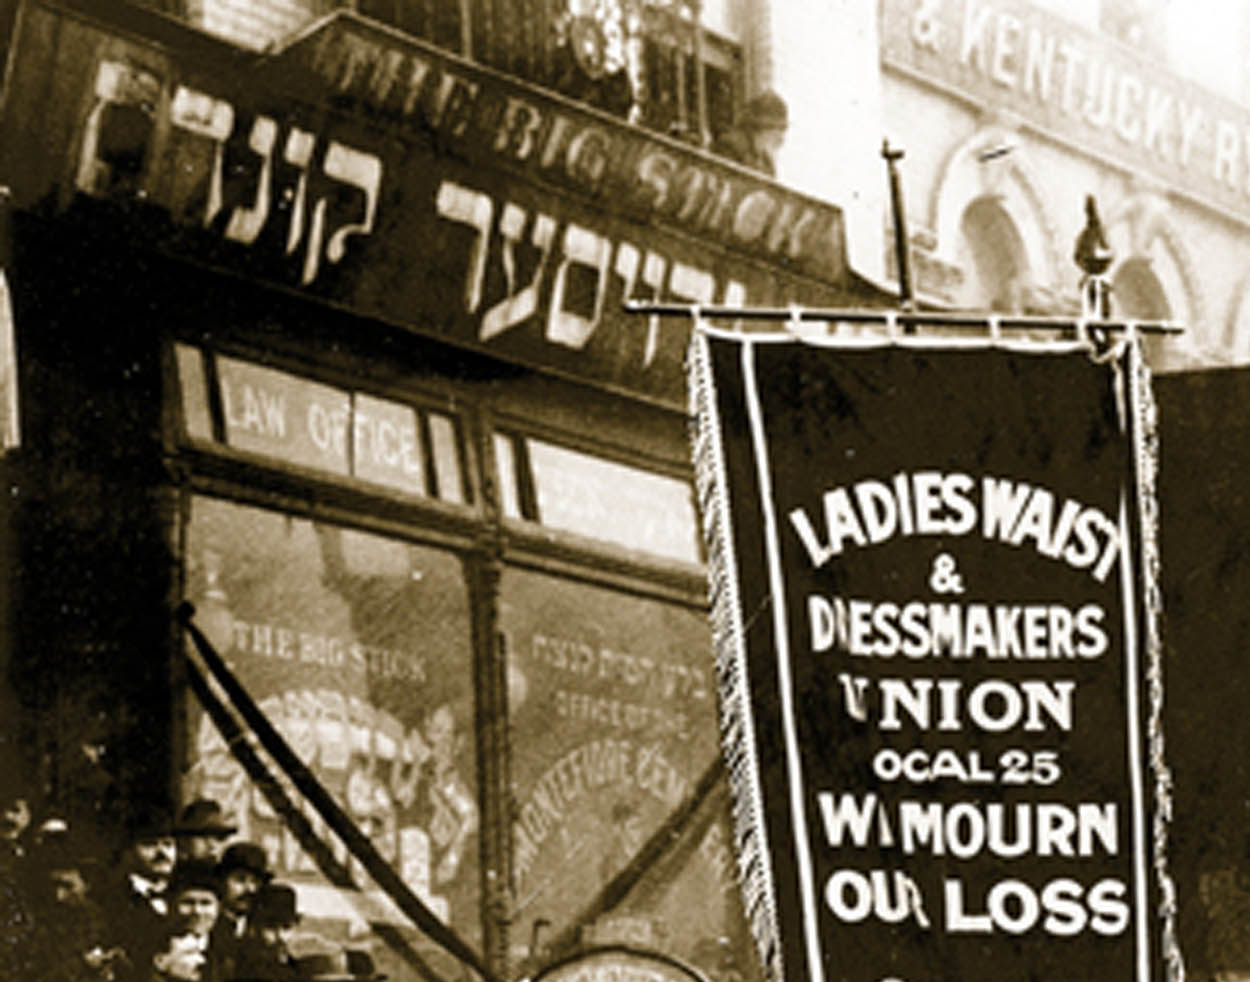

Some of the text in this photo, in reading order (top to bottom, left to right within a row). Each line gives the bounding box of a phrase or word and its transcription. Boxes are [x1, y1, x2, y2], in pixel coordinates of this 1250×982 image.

[961, 0, 1205, 168] KENTUCKY
[493, 95, 613, 178] BIG
[437, 182, 745, 368] רויסער
[222, 376, 422, 476] LAW OFFICE
[790, 472, 978, 568] LADIES
[982, 477, 1126, 582] WAIST
[930, 553, 964, 594] &
[232, 620, 294, 660] THE
[298, 631, 345, 667] BIG
[873, 750, 1061, 784] OCAL 25
[817, 793, 1118, 857] W MOURN
[945, 880, 1130, 936] LOSS
